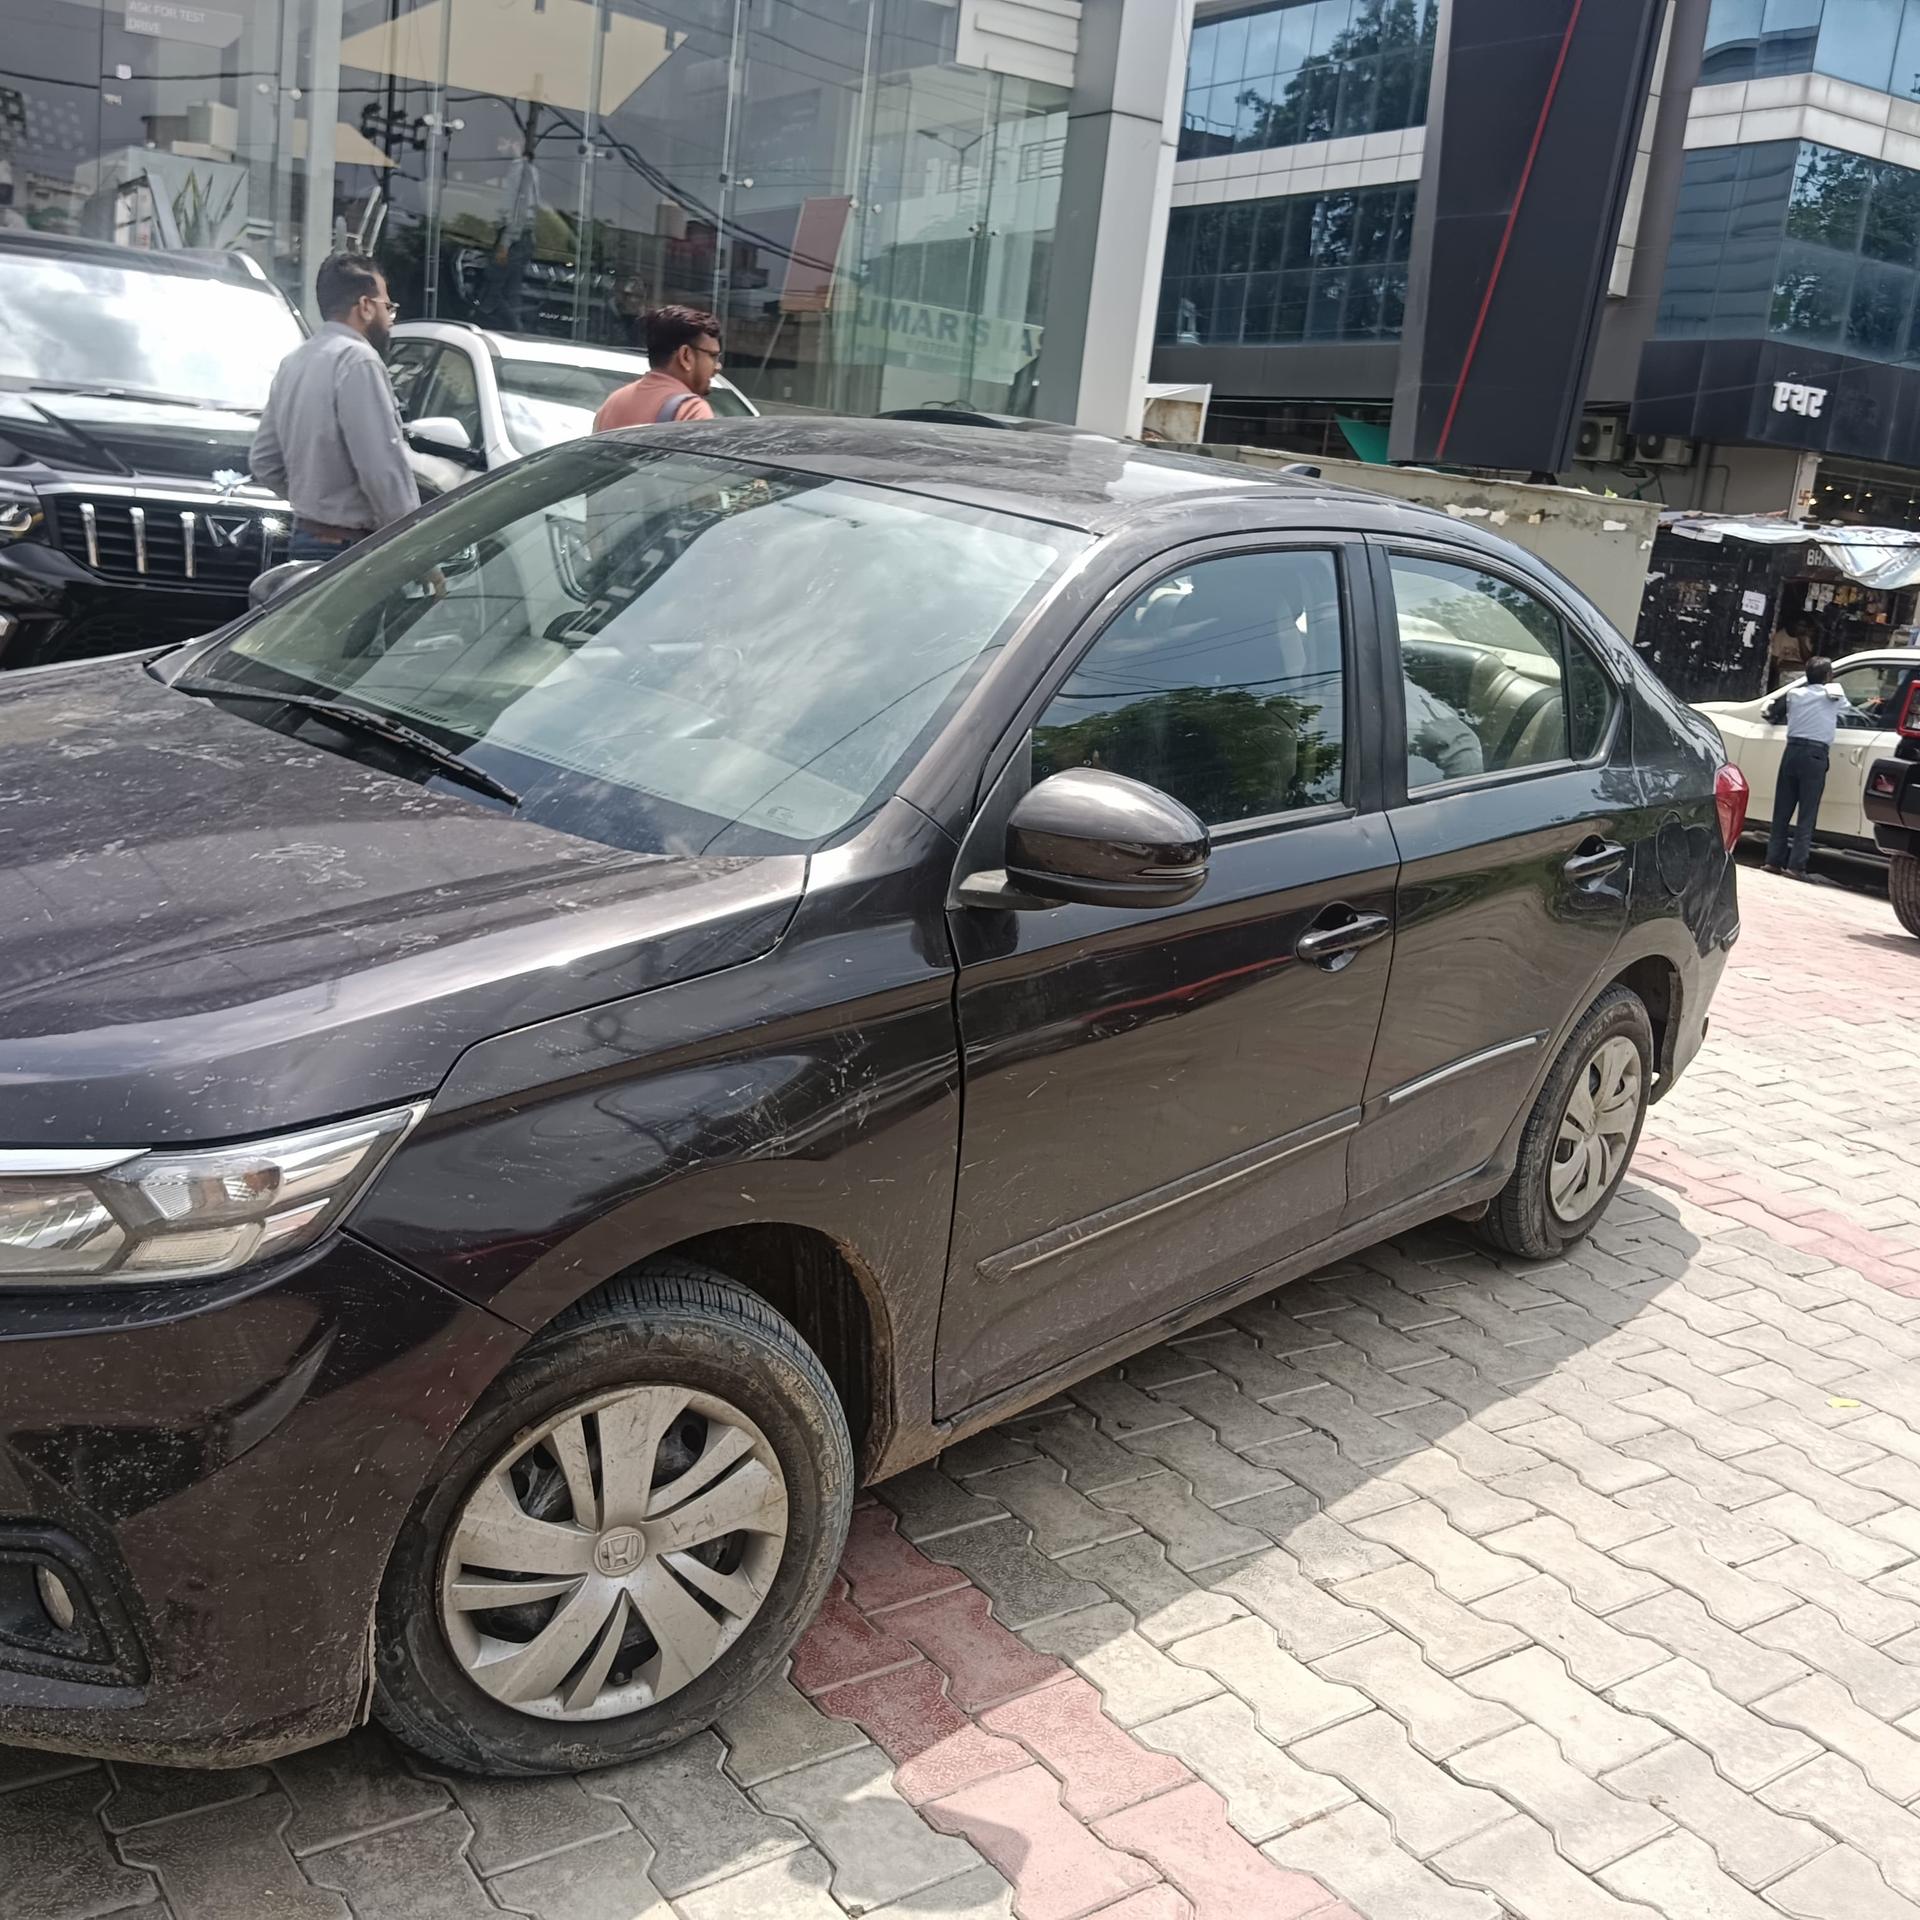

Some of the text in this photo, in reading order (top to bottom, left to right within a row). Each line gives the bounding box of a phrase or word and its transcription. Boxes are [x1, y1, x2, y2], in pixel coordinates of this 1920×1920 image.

[153, 5, 178, 18] FOR
[179, 9, 206, 23] TEST
[127, 17, 161, 34] DRIVE
